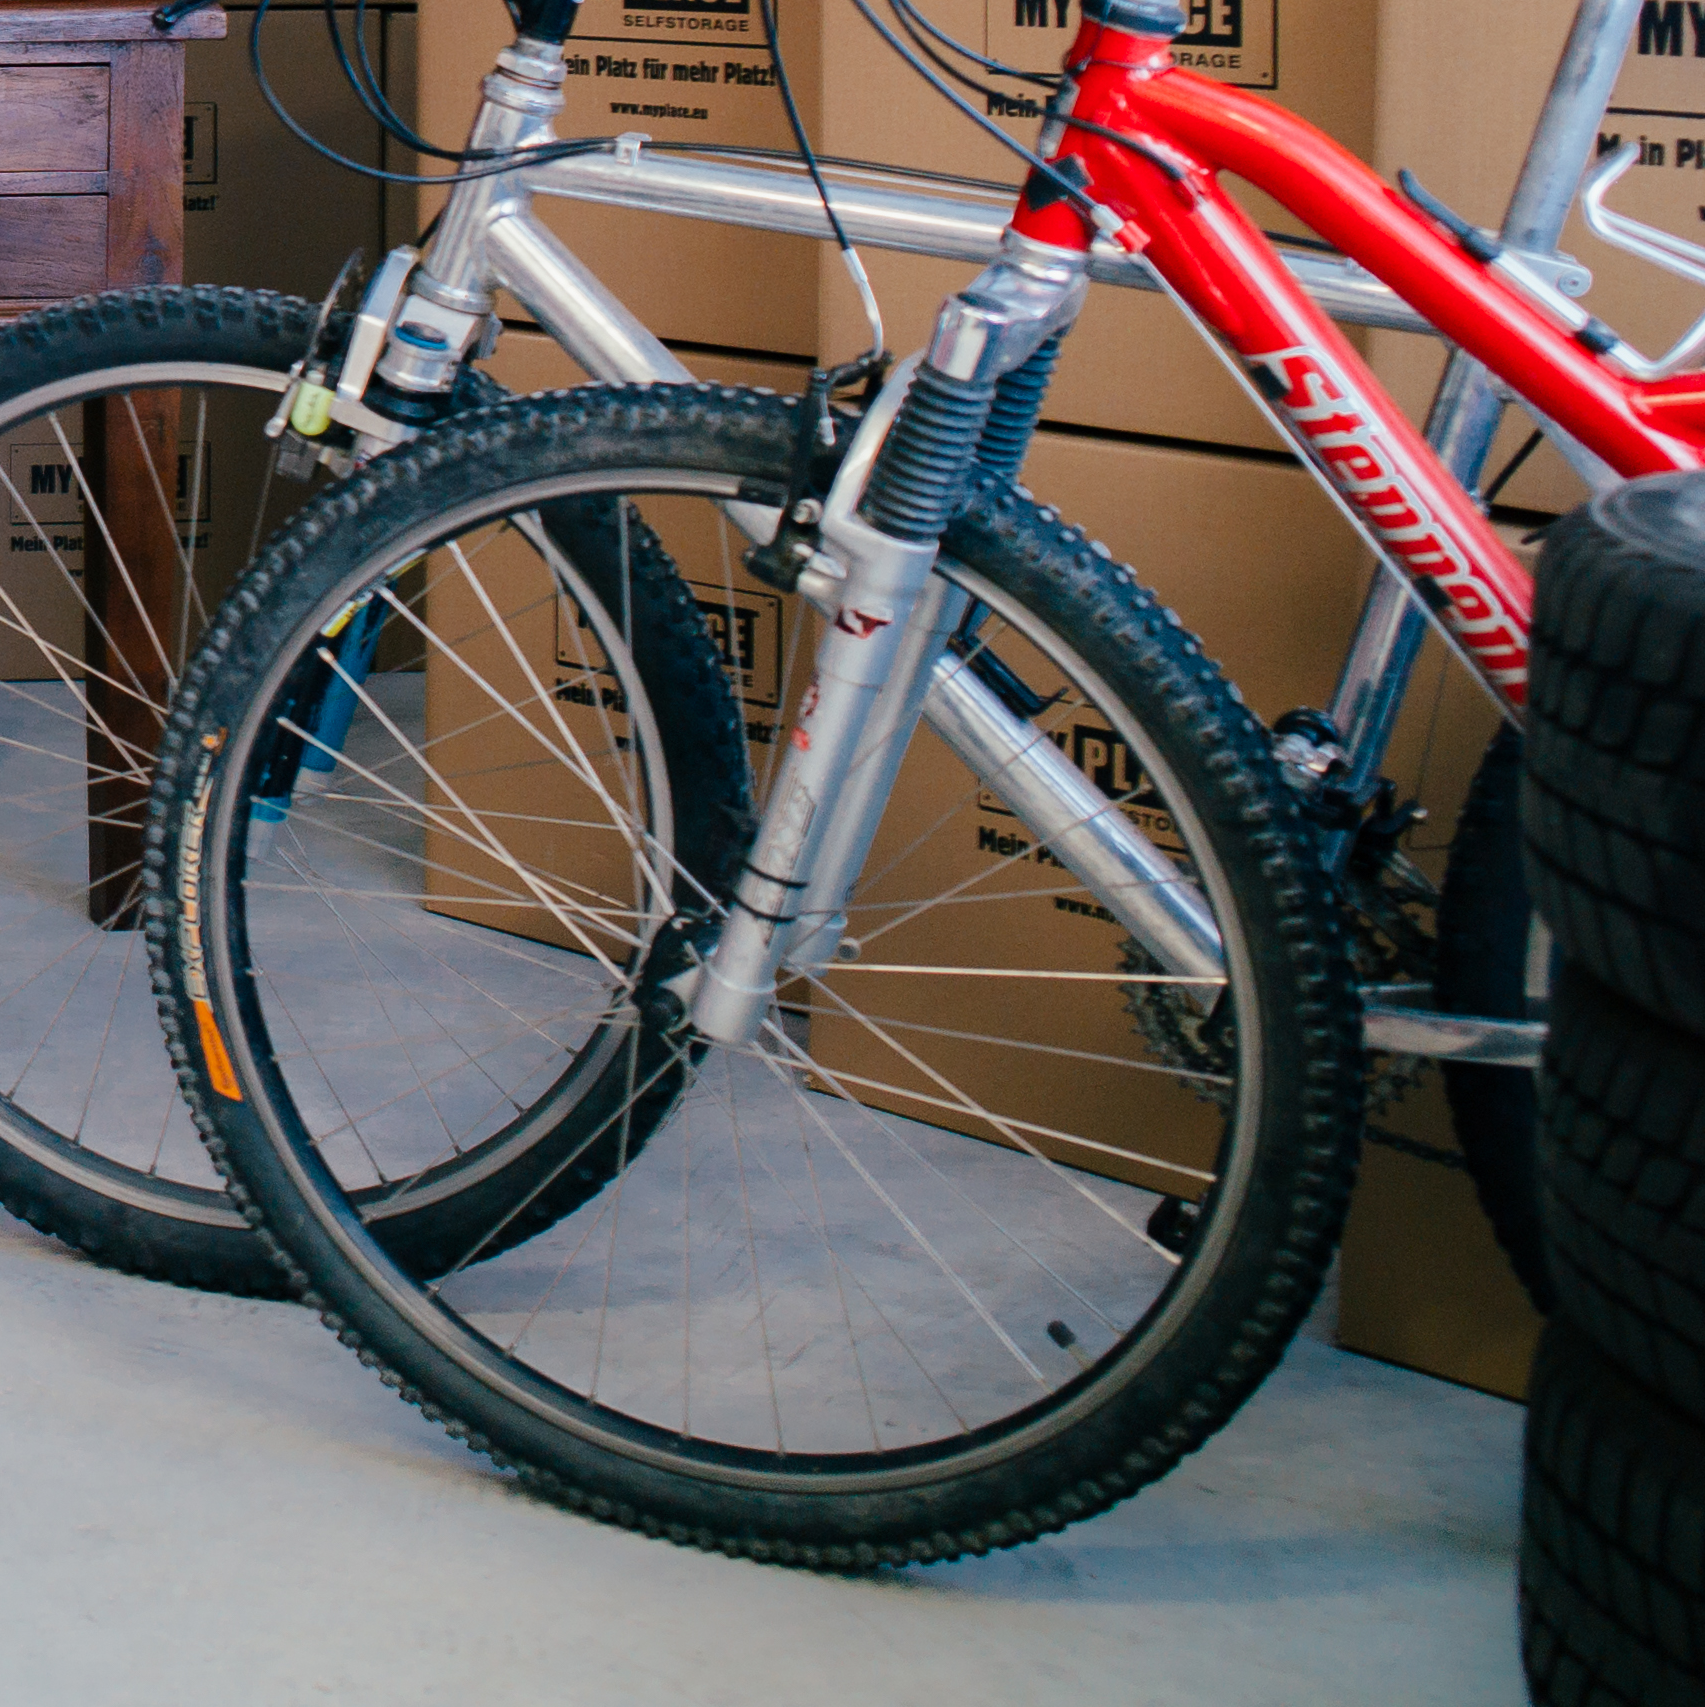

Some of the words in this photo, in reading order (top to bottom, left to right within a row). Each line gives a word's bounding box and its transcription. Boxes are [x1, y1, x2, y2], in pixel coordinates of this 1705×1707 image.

[623, 14, 749, 32] SELFSTORAGE
[563, 56, 590, 76] ein
[596, 55, 637, 79] Platz
[643, 58, 668, 81] für
[673, 61, 719, 84] mehr
[611, 102, 708, 120] www.myplace.eu
[1597, 133, 1665, 166] Min
[31, 464, 72, 494] MY
[53, 535, 83, 551] Plat
